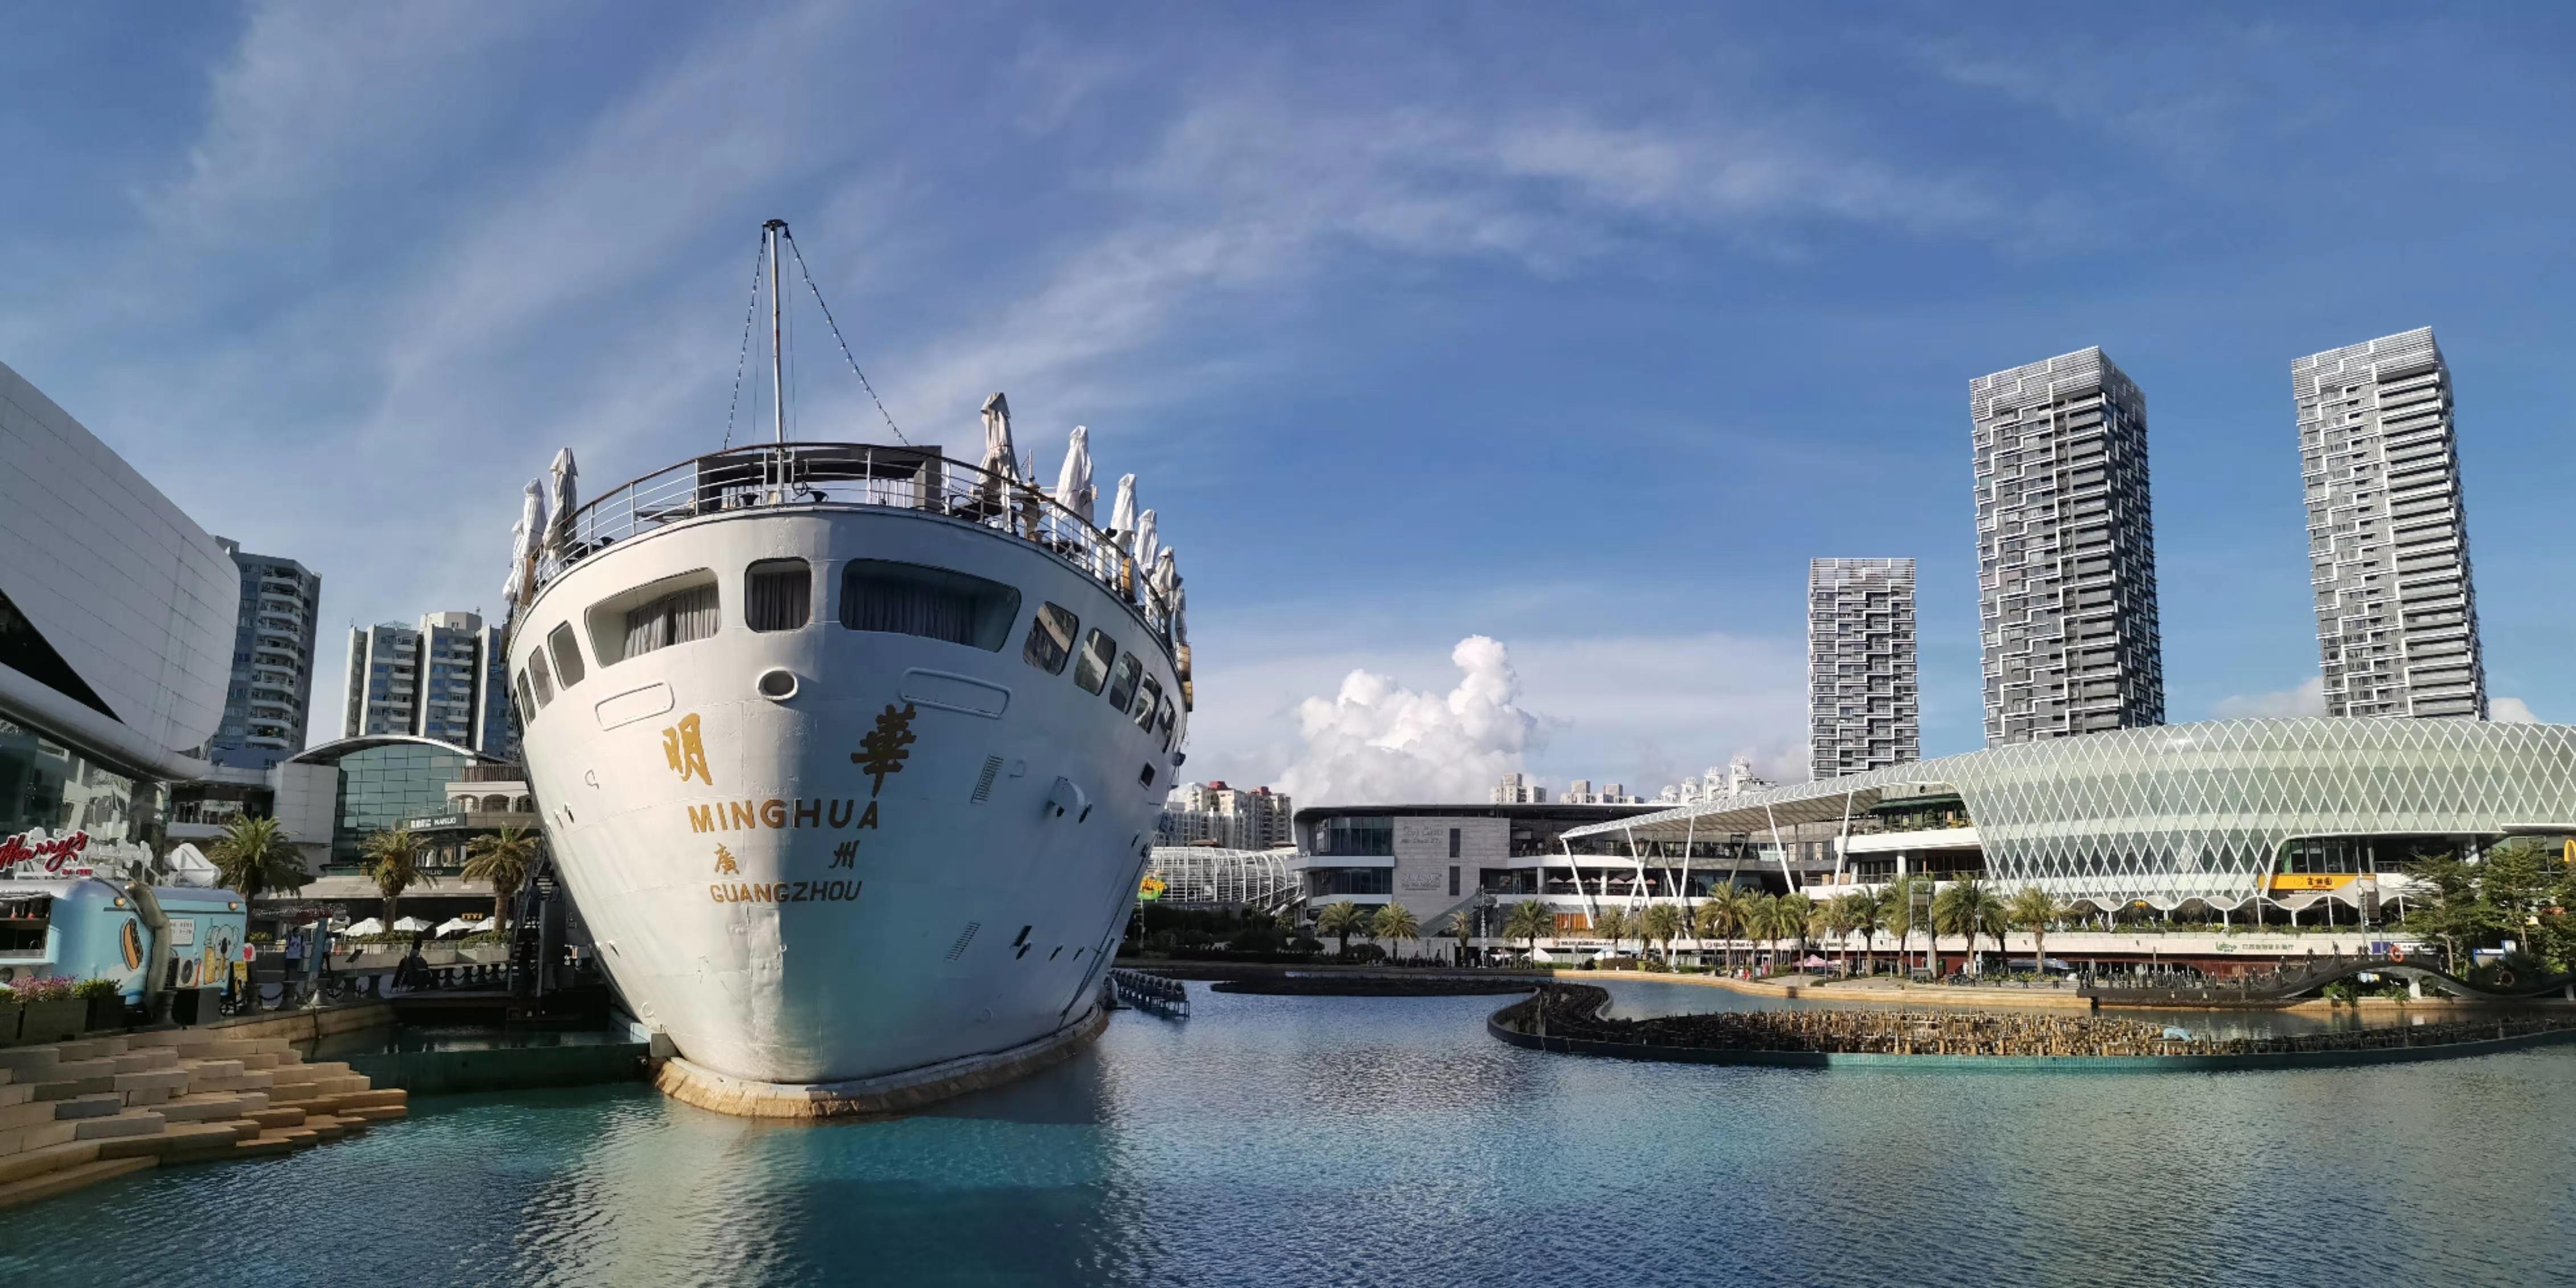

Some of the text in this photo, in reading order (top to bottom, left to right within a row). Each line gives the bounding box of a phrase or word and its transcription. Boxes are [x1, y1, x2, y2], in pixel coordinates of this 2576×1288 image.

[662, 703, 917, 798] 明 華
[687, 798, 878, 833] MINGHUA
[0, 830, 90, 872] Harry's
[713, 840, 860, 875] 廣 州
[709, 880, 863, 903] GUANGZHOU
